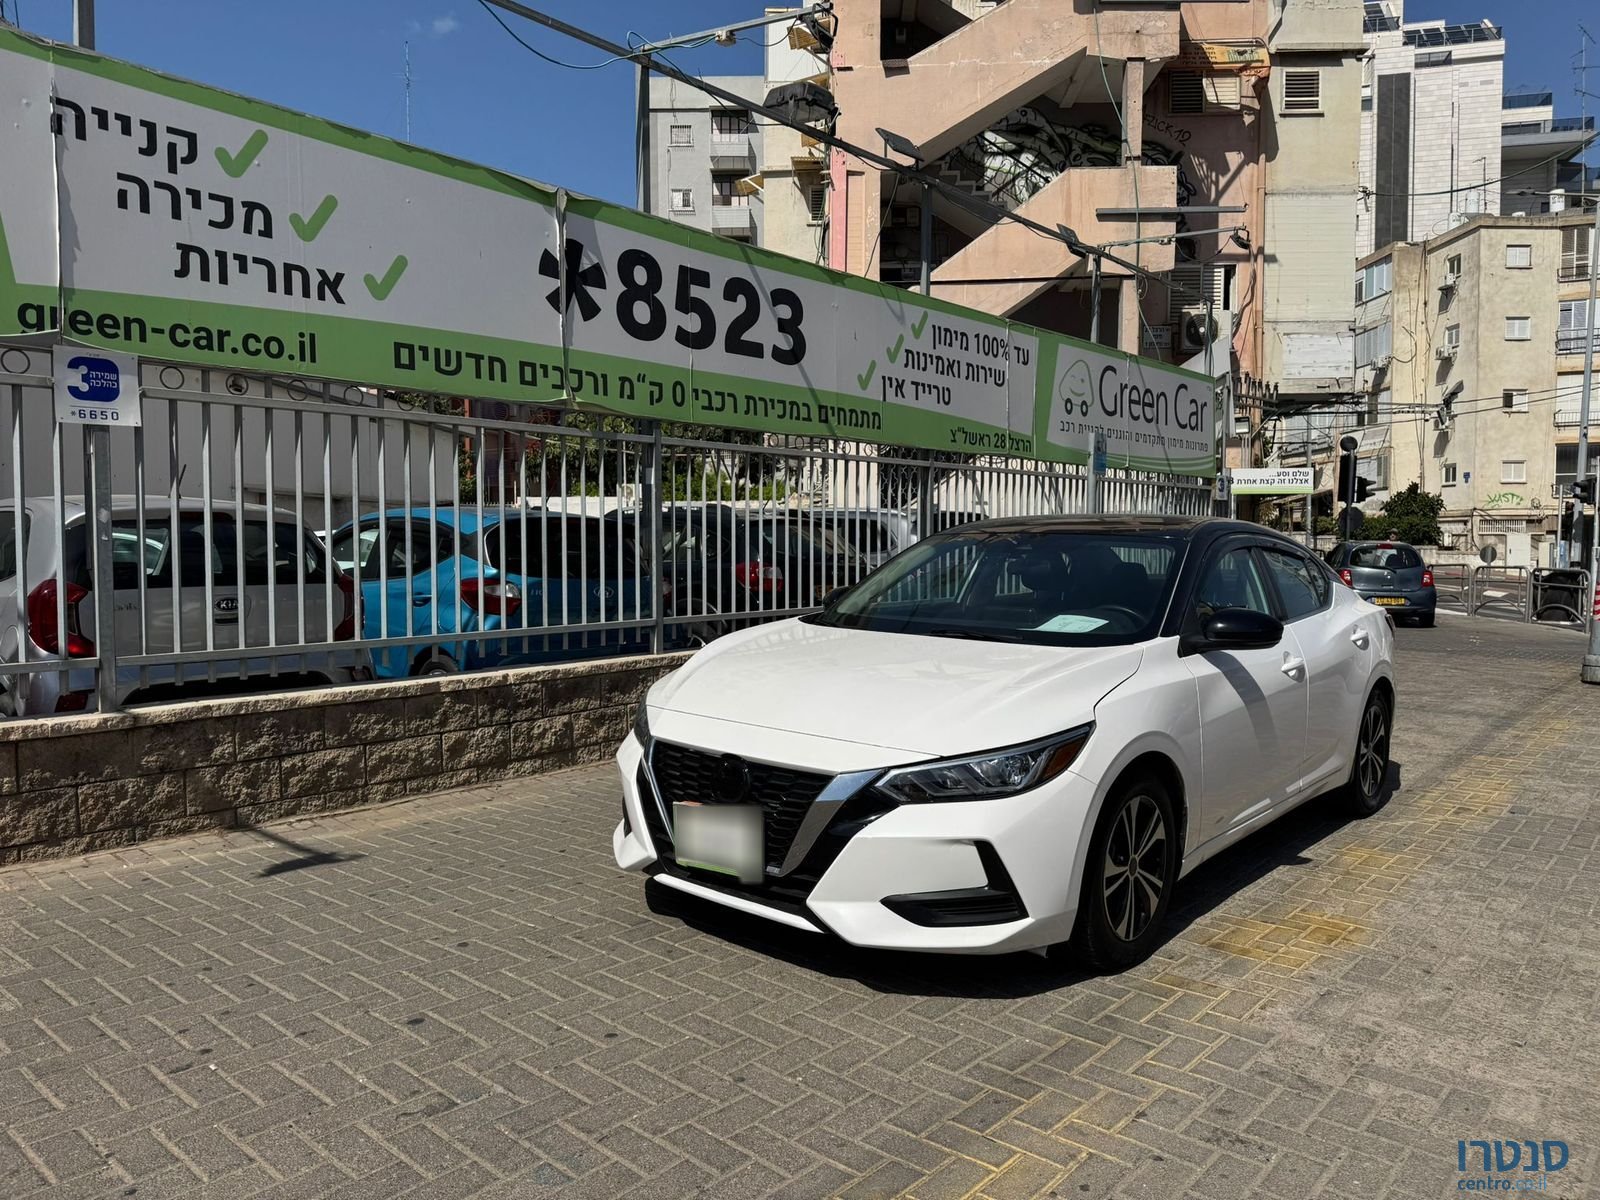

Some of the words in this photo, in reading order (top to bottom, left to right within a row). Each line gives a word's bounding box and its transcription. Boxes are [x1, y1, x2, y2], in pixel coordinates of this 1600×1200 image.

[50, 96, 198, 175] קנייה
[116, 172, 273, 239] מכירה
[174, 242, 345, 304] אחריות
[17, 303, 317, 364] green-car.co.il
[932, 324, 969, 351] מימון
[974, 333, 1009, 361] 100%
[393, 341, 507, 383] חדשים
[904, 349, 961, 379] ואמינות
[1013, 346, 1029, 366] עד
[89, 371, 117, 380] שמירה
[90, 380, 118, 388] כהלכה
[518, 360, 608, 396] ורכבים
[965, 360, 1006, 387] שירות
[672, 380, 686, 408] 0
[692, 388, 738, 413] רכבי
[881, 375, 906, 402] אין
[911, 381, 951, 406] טרייד
[1099, 365, 1168, 426] Green
[1174, 383, 1208, 433] Car
[744, 394, 812, 423] במכירת
[818, 404, 882, 430] מתמחים
[1060, 420, 1076, 432] רכב
[994, 433, 1006, 449] 28
[1008, 433, 1032, 452] הרצל
